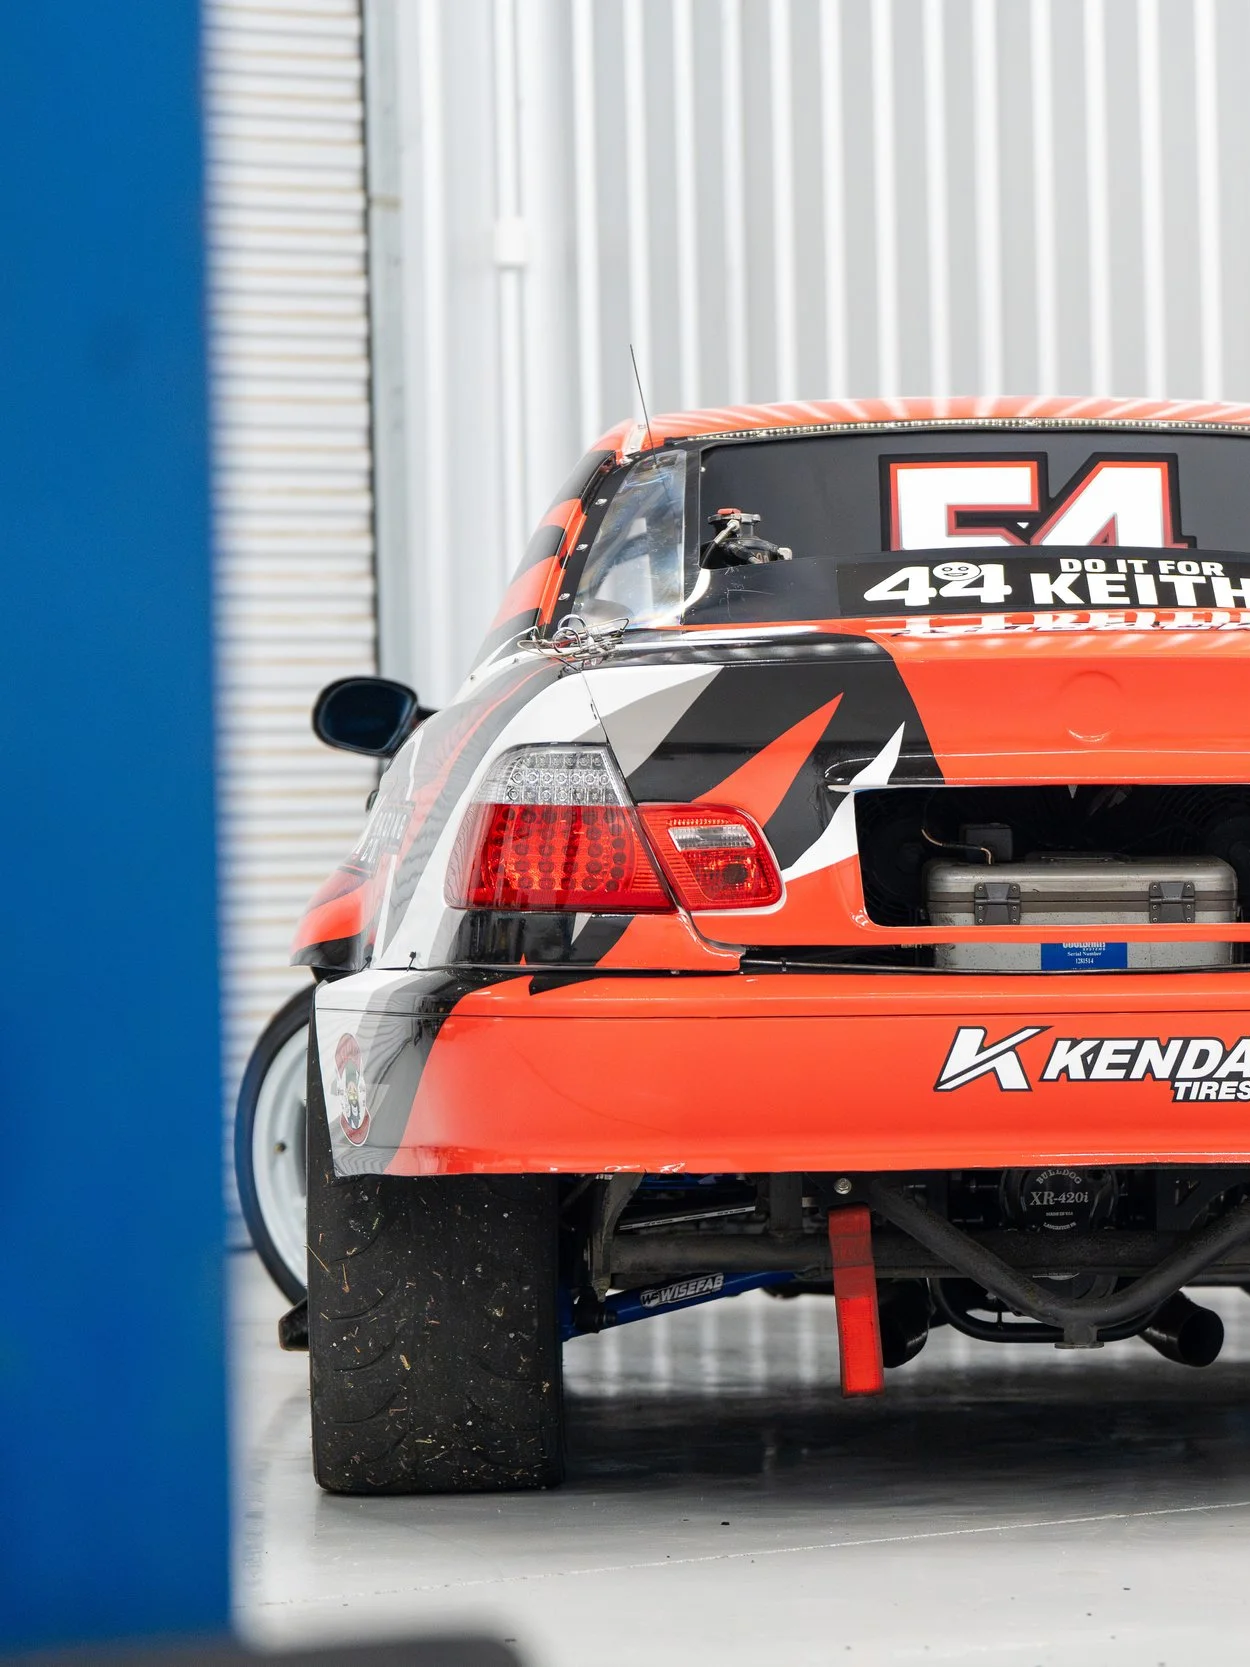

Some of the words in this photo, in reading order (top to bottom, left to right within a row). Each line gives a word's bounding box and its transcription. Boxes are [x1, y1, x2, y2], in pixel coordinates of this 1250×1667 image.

[880, 454, 1192, 551] 54
[1061, 558, 1101, 574] DO
[1119, 559, 1148, 574] IT
[1159, 561, 1225, 577] FOR
[1036, 1169, 1082, 1185] BULLDOG
[1029, 1191, 1089, 1206] XR-420i
[660, 1275, 724, 1302] WISEFAB
